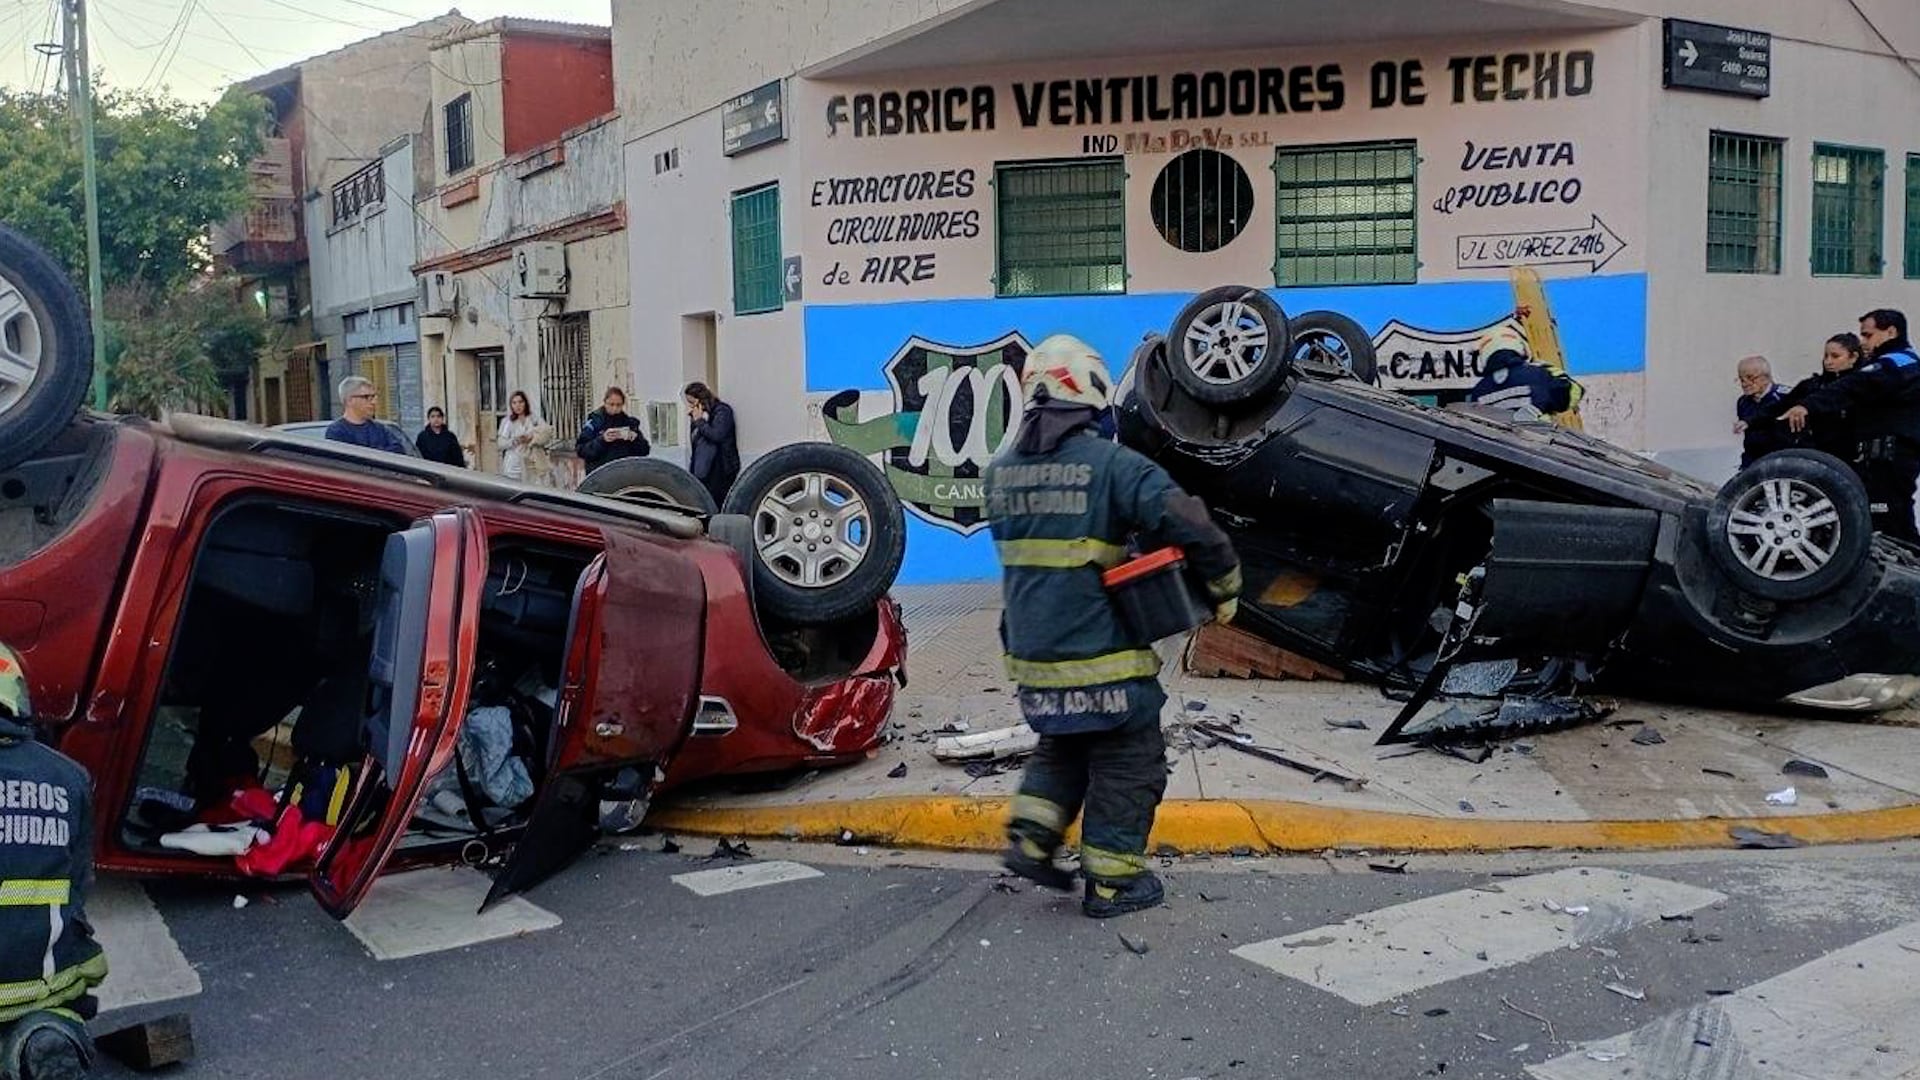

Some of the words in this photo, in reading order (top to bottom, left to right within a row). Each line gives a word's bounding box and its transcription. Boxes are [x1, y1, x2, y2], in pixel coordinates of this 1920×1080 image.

[827, 85, 996, 138] FABRICA
[1012, 63, 1346, 128] VENTILADORES
[1370, 59, 1428, 108] DE
[1446, 50, 1594, 104] TECHO
[1083, 135, 1118, 153] IND
[1460, 140, 1575, 172] VENTA
[811, 169, 975, 207] EXTRACTORES
[1456, 178, 1582, 209] PUBLICO
[827, 210, 979, 245] CIRCULADORES
[1494, 236, 1567, 261] SUAREZ
[822, 258, 850, 286] de
[860, 253, 937, 286] AIRE
[908, 363, 1025, 468] 100
